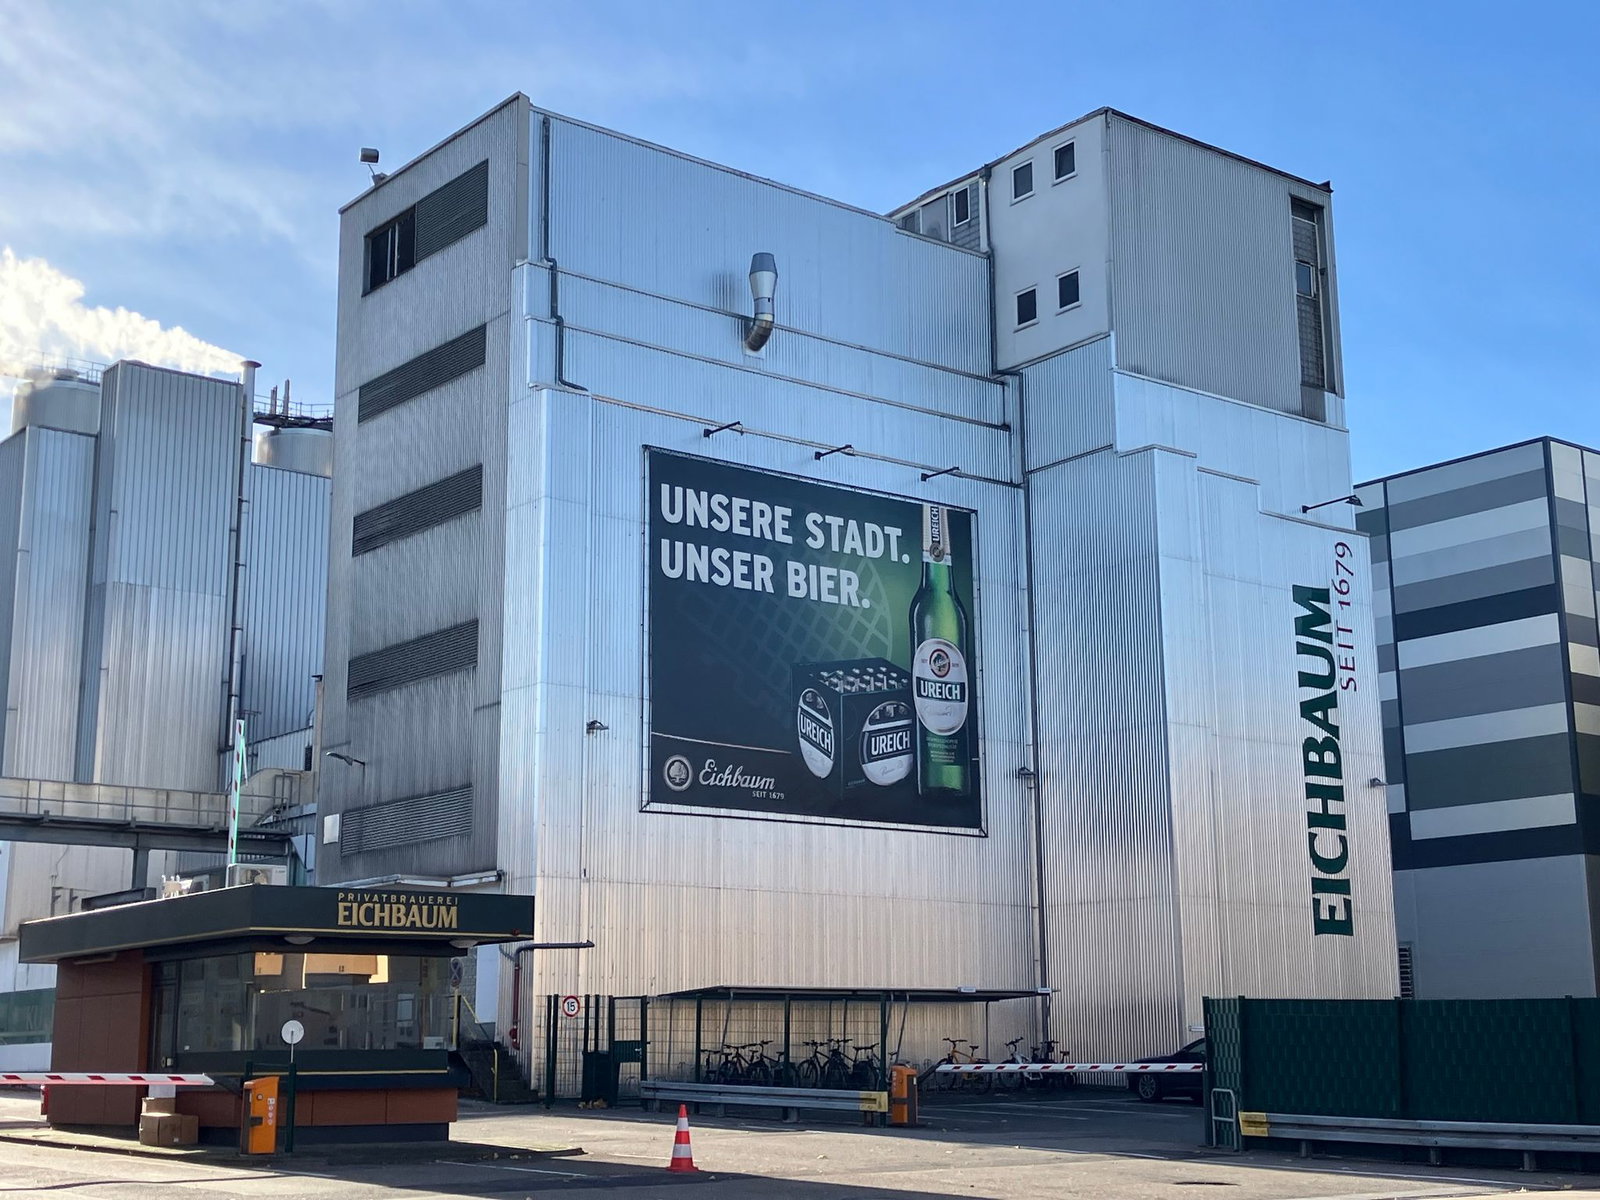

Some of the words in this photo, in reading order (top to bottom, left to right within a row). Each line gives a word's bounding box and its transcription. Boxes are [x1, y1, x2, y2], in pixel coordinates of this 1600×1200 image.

[660, 483, 793, 544] UNSERE
[805, 512, 910, 564] STADT.
[931, 507, 940, 541] UREICH
[660, 538, 774, 594] UNSER
[786, 560, 871, 609] BIER.
[1331, 541, 1354, 611] 1679
[1335, 619, 1357, 692] SEIT
[920, 680, 961, 700] UREICH
[800, 713, 832, 752] UREICH
[871, 730, 911, 756] UREICH
[699, 759, 776, 790] Eichbaum
[1292, 584, 1354, 937] EICHBAUM
[752, 791, 767, 799] SEIT
[769, 791, 785, 800] 1679
[338, 892, 458, 905] PRIVATBRAUEREI
[337, 902, 458, 929] EICHBAUM
[566, 1001, 576, 1012] 15
